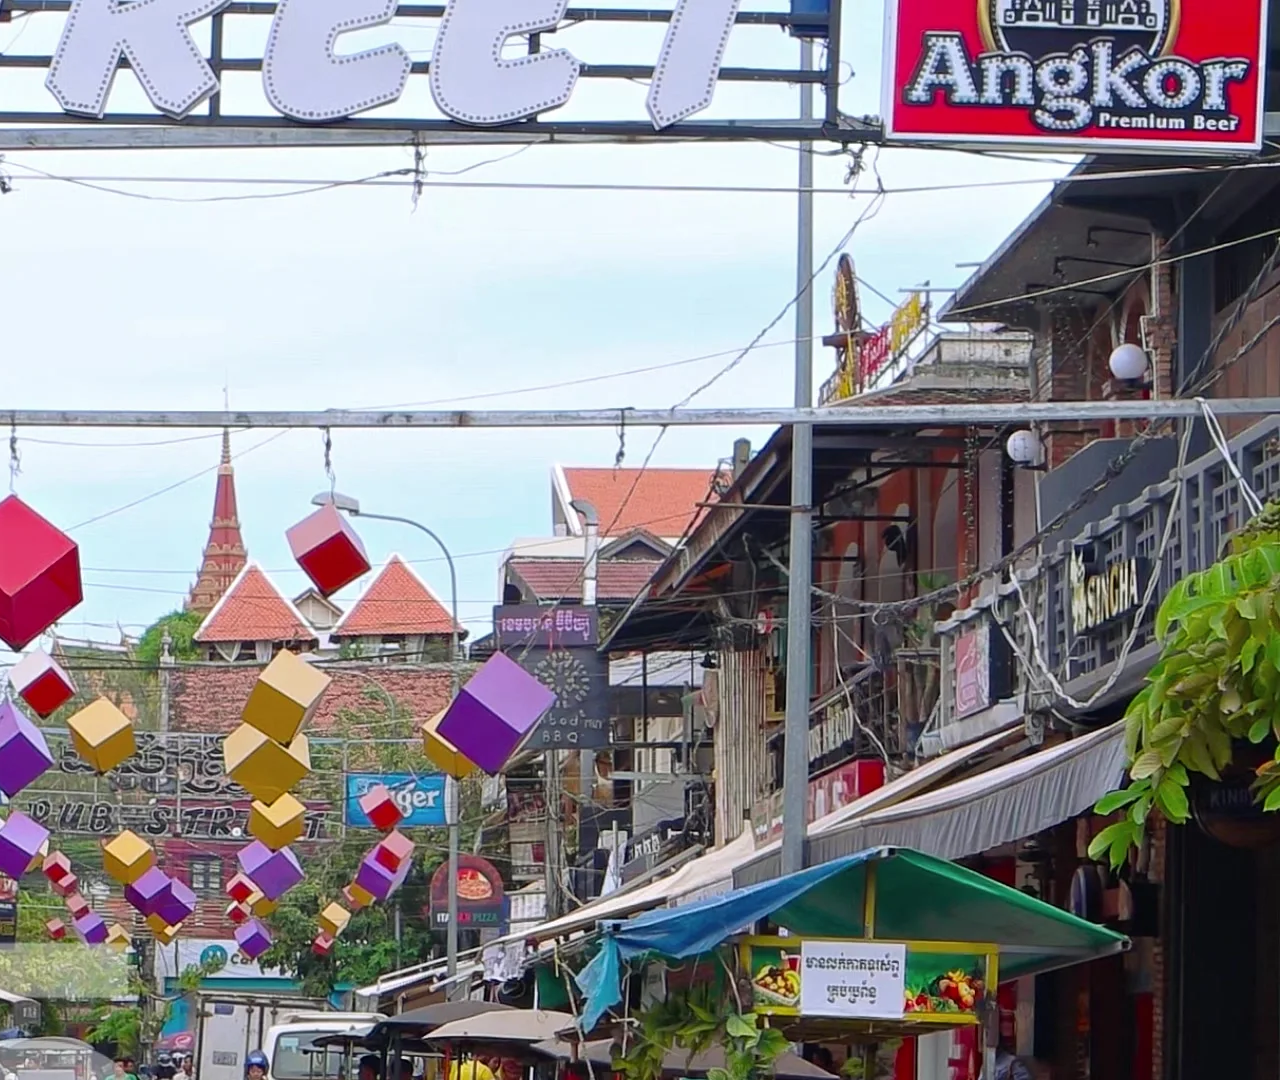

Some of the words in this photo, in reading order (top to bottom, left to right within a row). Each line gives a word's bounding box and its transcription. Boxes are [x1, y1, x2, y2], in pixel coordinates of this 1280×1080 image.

[903, 30, 1250, 131] Angkor
[1098, 113, 1186, 130] Premium
[1193, 114, 1239, 132] Beer
[1087, 556, 1140, 629] SINGHA
[28, 798, 114, 834] PUB
[143, 805, 328, 840] STRT
[436, 912, 472, 924] ITAAN
[472, 912, 498, 922] PIZZA
